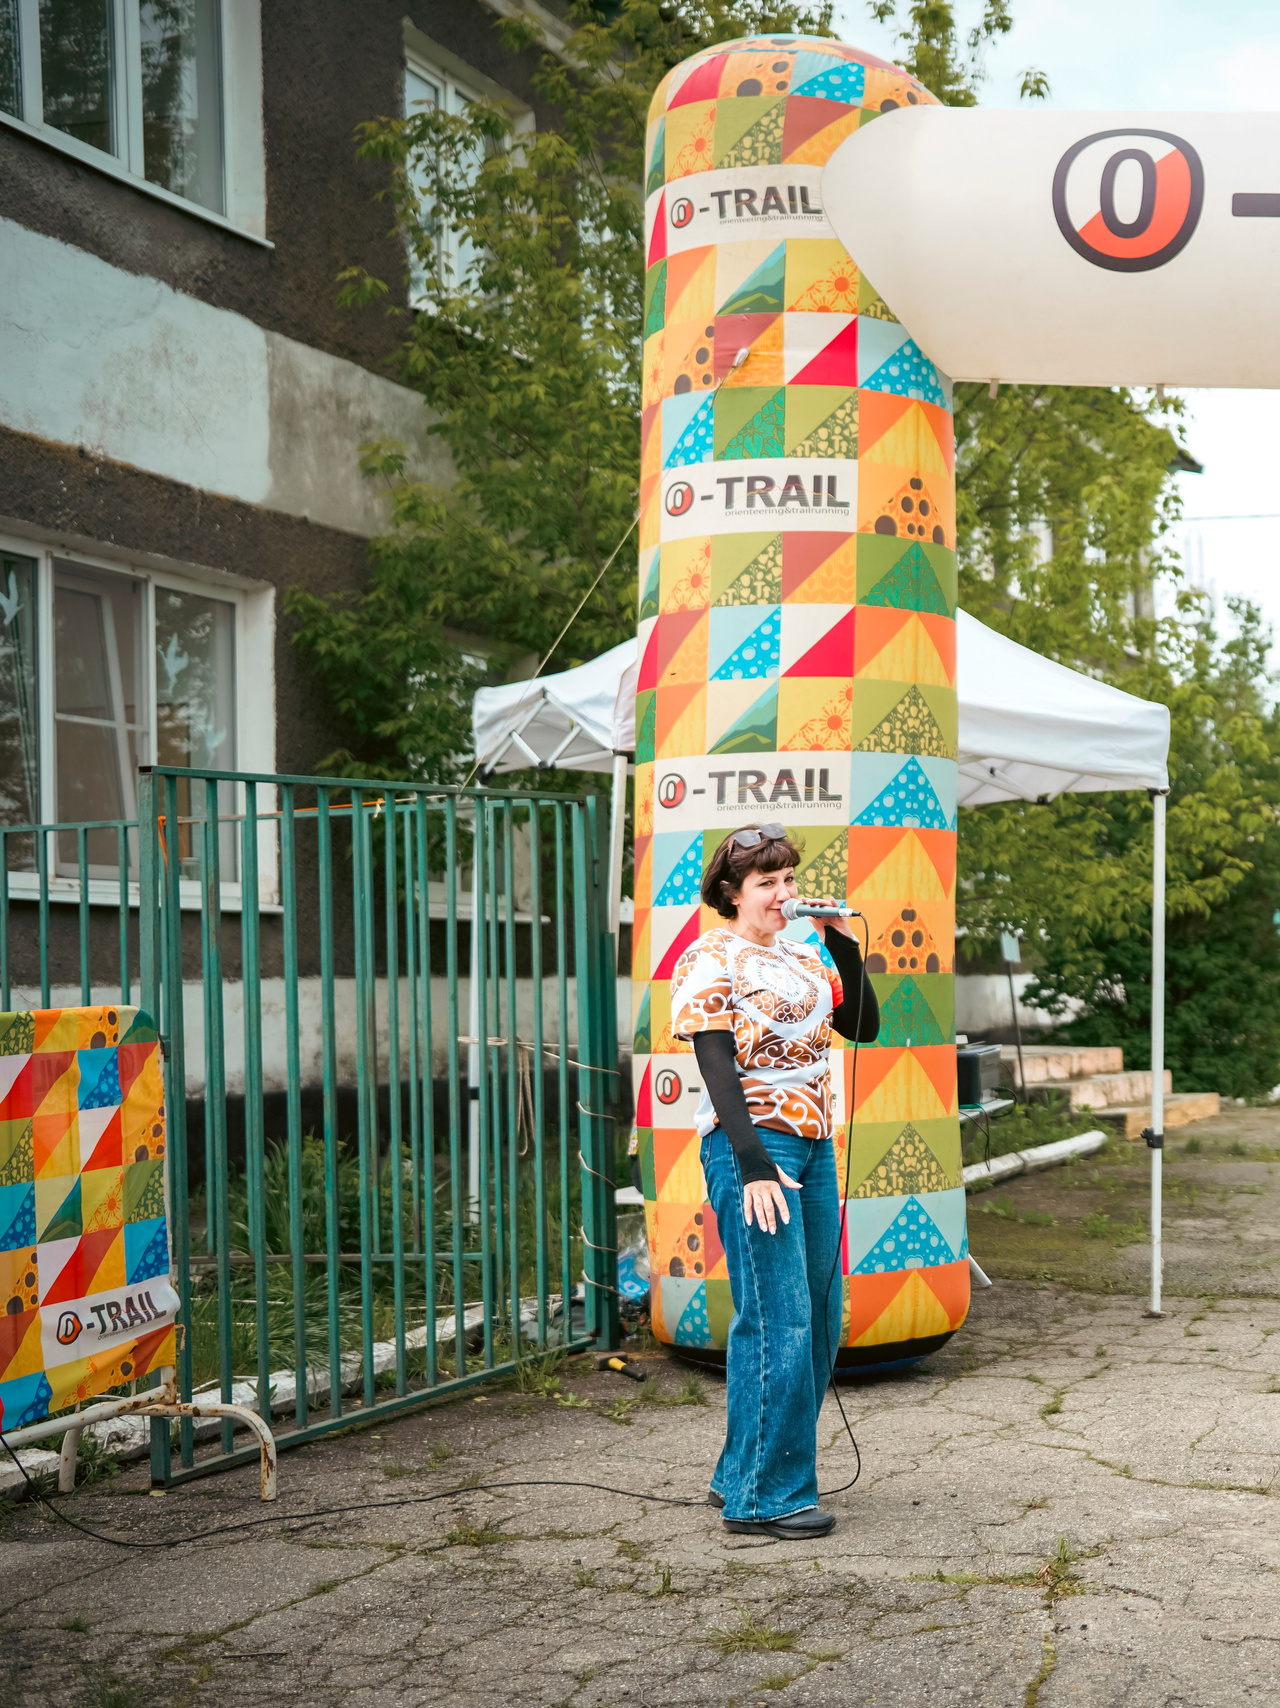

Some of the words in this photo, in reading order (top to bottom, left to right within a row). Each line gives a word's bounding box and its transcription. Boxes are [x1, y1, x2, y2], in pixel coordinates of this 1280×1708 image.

[719, 213, 823, 225] orienteering&trailrunning
[725, 506, 850, 517] orienteering&trailrunning
[716, 800, 842, 812] orienteering&trailrunning
